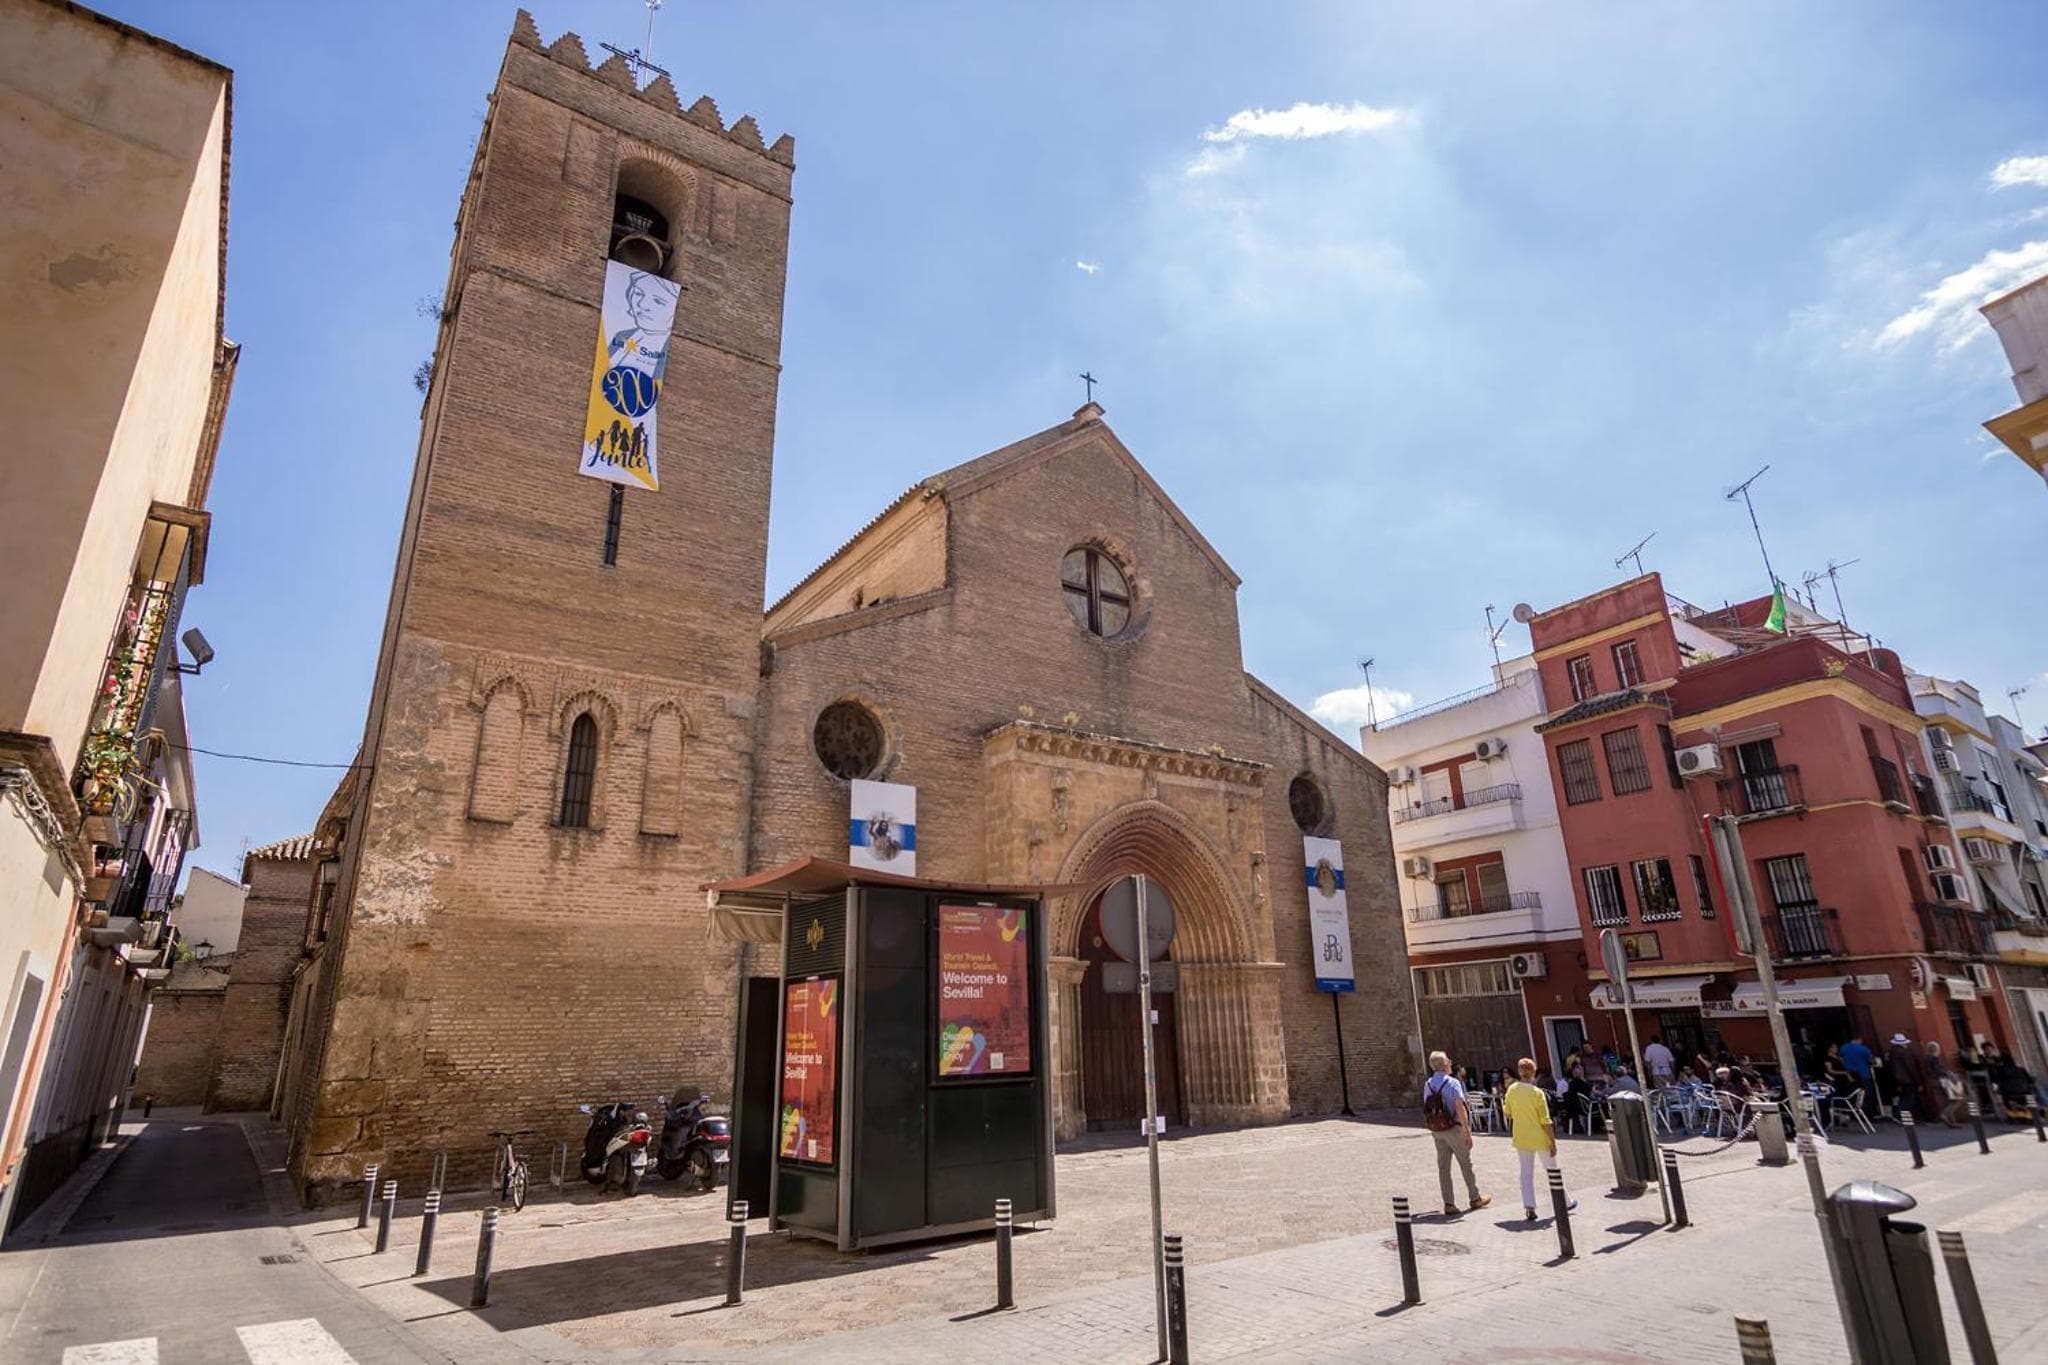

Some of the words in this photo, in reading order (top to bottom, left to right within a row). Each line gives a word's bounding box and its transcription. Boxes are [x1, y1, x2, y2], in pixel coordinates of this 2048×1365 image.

[943, 971, 993, 984] Welcome
[996, 973, 1008, 984] to
[943, 986, 984, 999] Sevilla!
